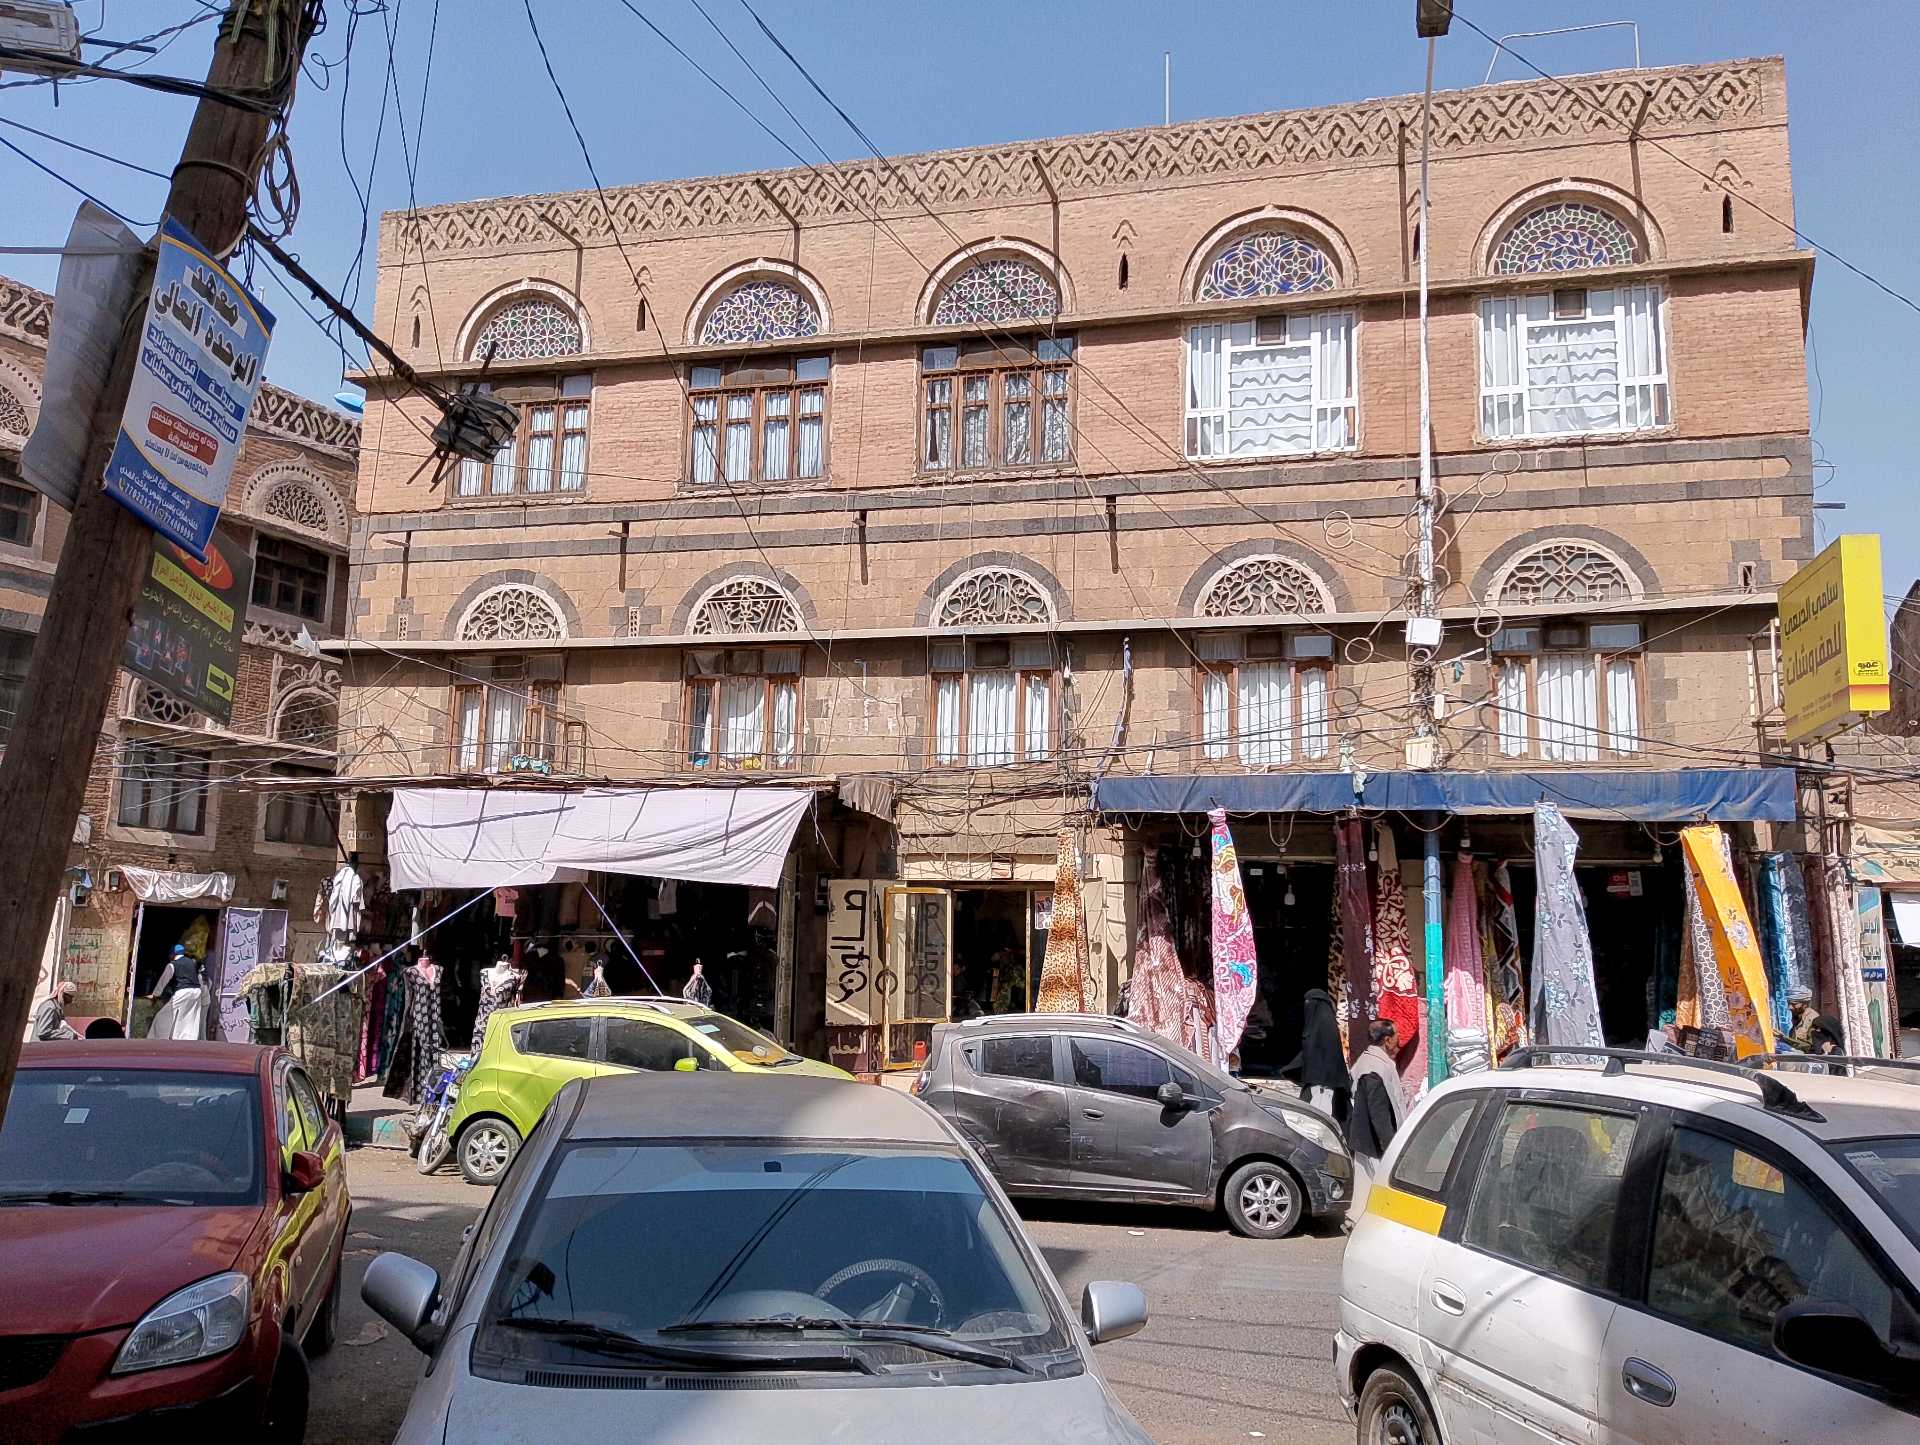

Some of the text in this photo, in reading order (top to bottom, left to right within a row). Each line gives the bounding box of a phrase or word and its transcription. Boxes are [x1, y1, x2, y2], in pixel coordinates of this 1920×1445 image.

[190, 265, 239, 327] معهد
[154, 280, 258, 387] الوحدة العالي
[1812, 581, 1839, 621] سامي
[1786, 620, 1842, 686] للمفروشات
